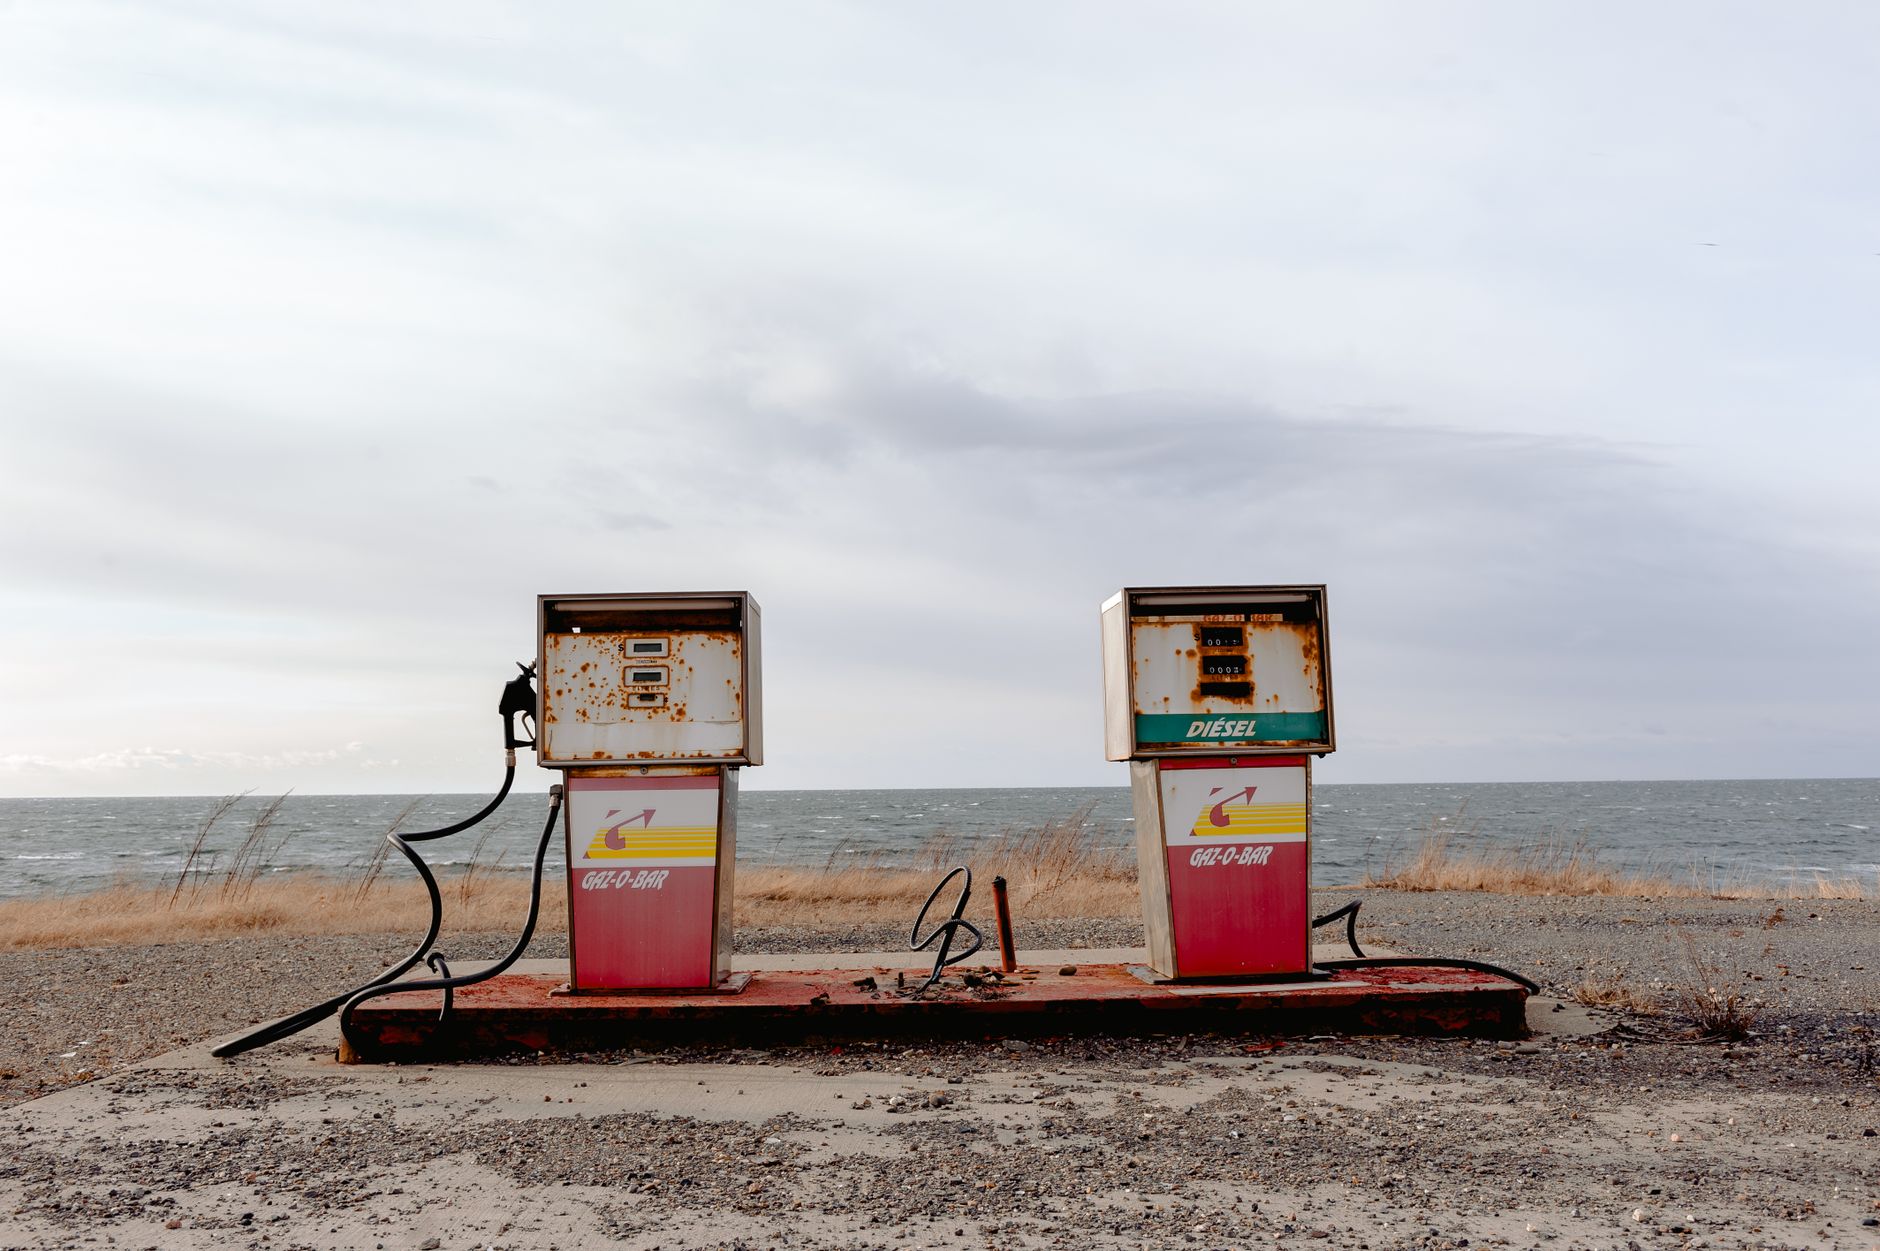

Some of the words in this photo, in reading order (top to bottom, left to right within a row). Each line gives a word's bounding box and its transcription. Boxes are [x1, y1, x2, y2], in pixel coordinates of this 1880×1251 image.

[618, 643, 624, 652] $
[1186, 717, 1256, 738] DIÉSEL
[1189, 846, 1274, 868] GAZ-O-BAR
[581, 870, 670, 891] GAZ-O-BAR
